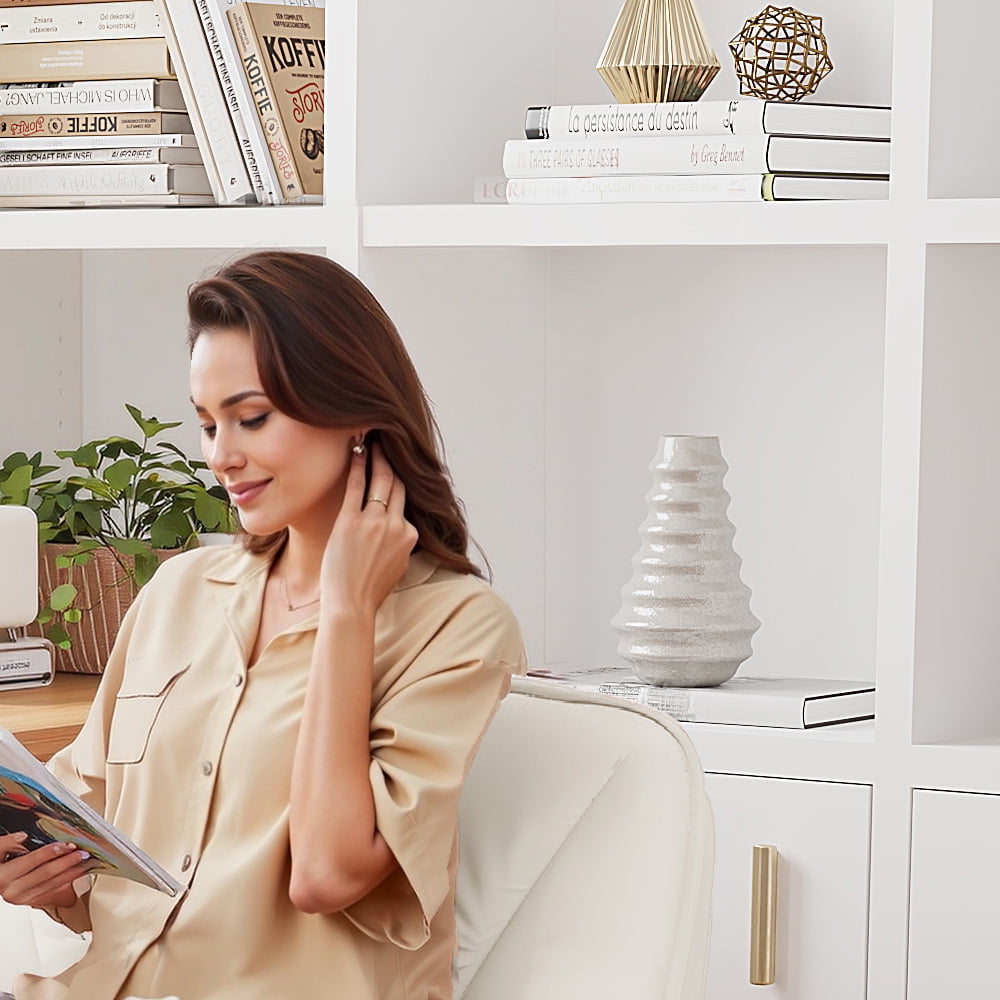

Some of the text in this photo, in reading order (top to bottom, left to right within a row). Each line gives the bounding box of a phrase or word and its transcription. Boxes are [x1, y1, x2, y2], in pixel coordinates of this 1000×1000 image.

[244, 53, 273, 116] KOFFIE
[5, 88, 152, 106] WHO IS MICHAEL JANG?
[285, 82, 325, 123] STORI
[67, 116, 118, 133] KOFFIE
[568, 103, 698, 138] La persistance du destin
[529, 148, 619, 168] THREE PAIRS OF GLASSES
[690, 144, 699, 166] by
[700, 144, 718, 166] Greg
